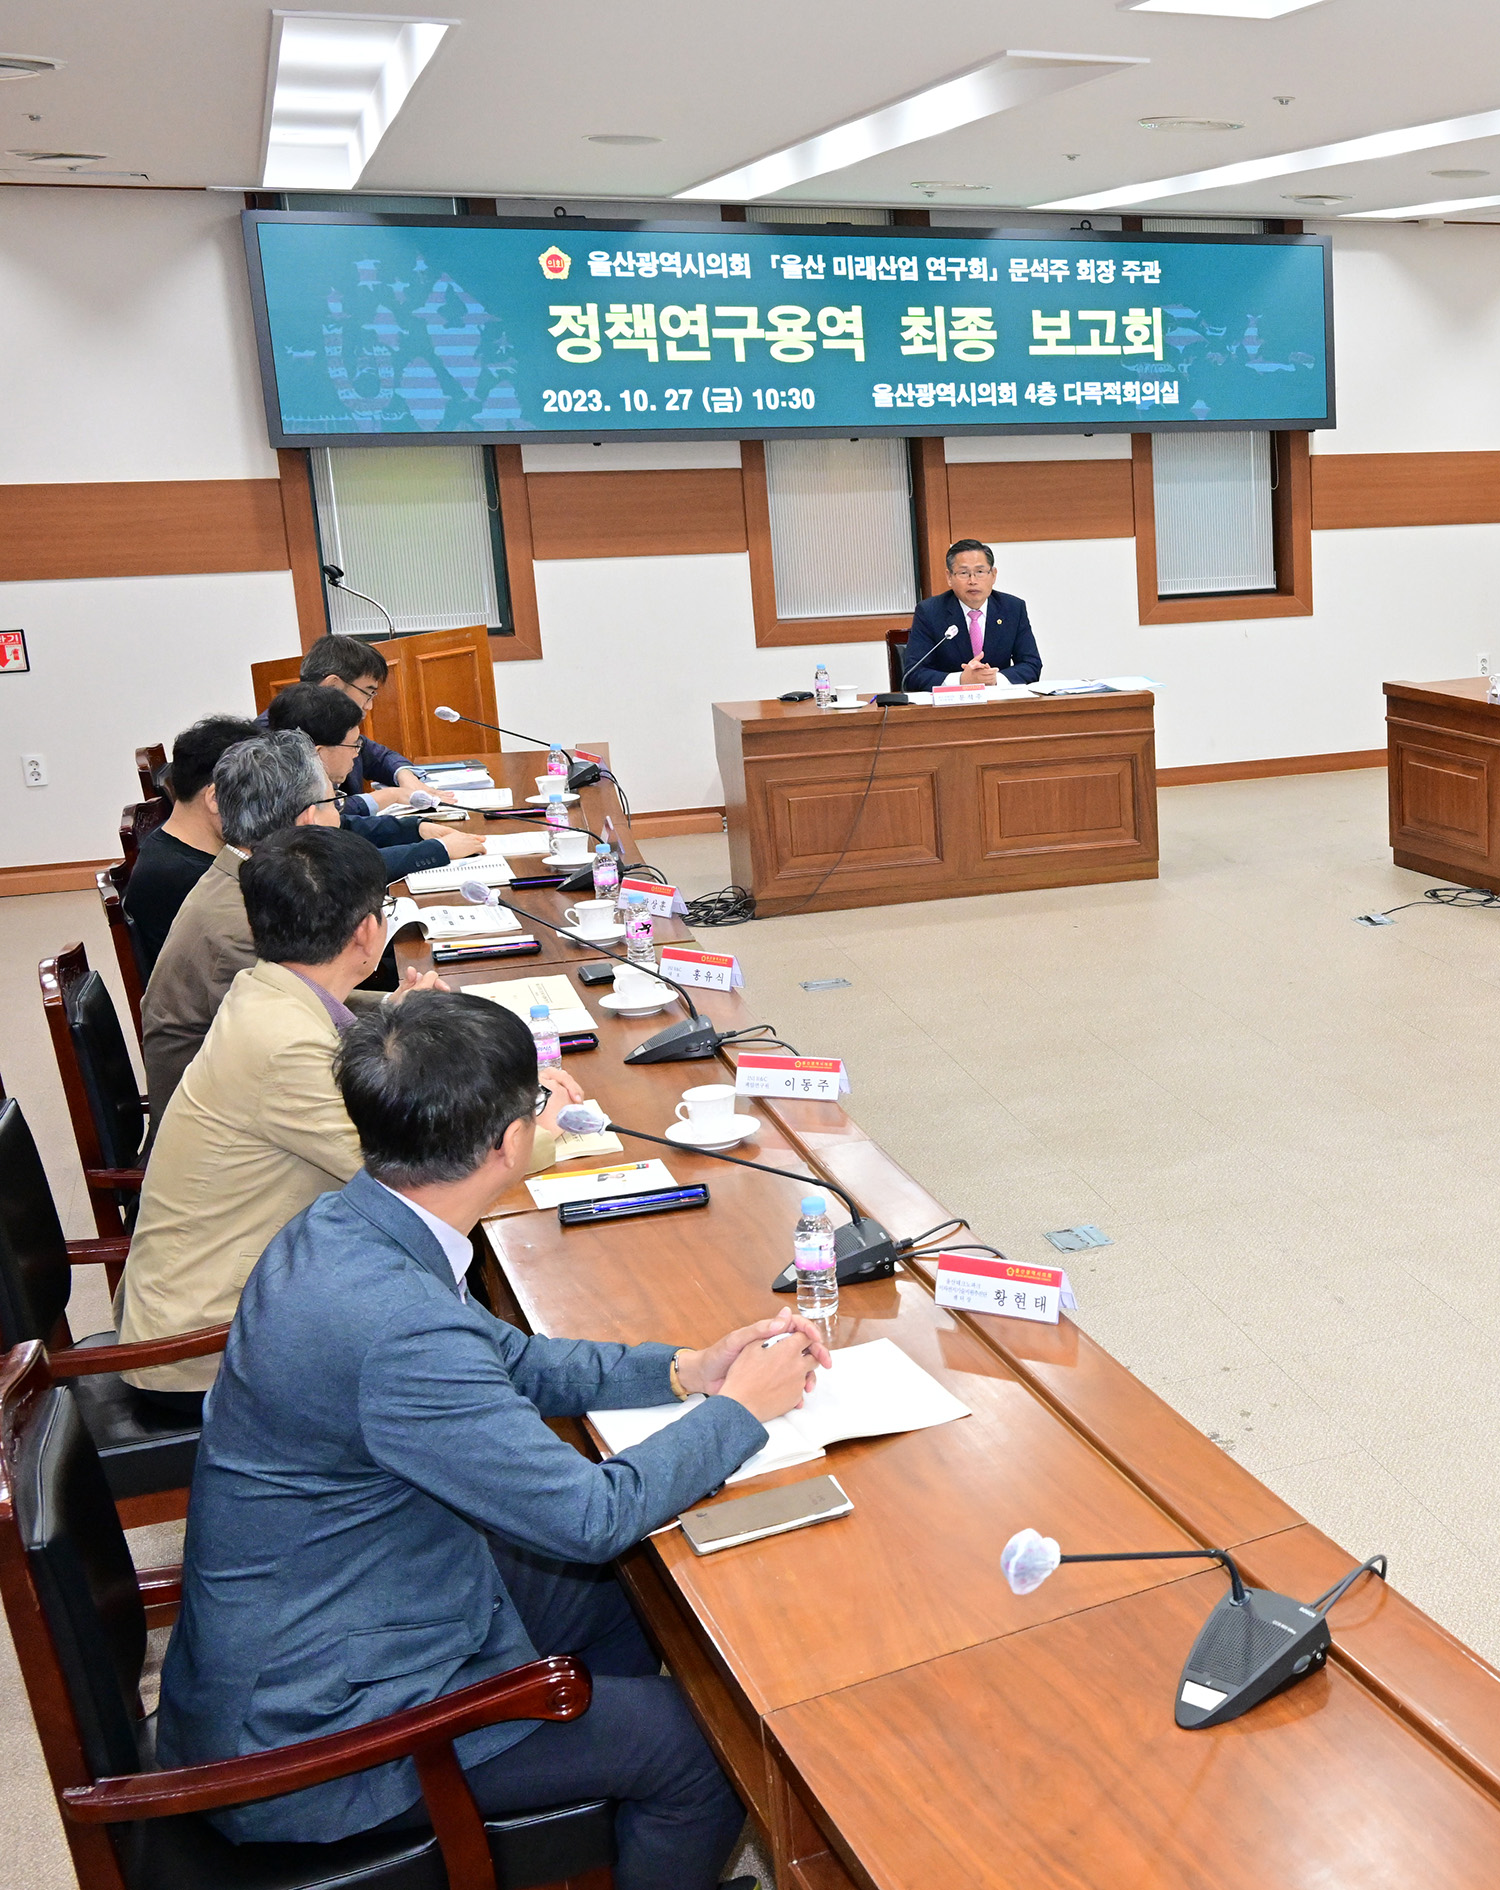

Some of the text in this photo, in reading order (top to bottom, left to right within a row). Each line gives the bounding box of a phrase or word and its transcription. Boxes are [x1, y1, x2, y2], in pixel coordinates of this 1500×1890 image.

[587, 250, 751, 279] 울산광역시의회
[833, 254, 919, 281] 미래산업
[1008, 258, 1070, 283] 문석주
[1076, 259, 1116, 284] 회장
[1121, 260, 1161, 284] 주관
[548, 302, 1164, 363] 정책연구용역 최종 보고회
[542, 386, 816, 413] 2023. 10. 27 (금) 10:30
[872, 380, 1179, 407] 울산광역시의회 4층 다목적회의실
[784, 1077, 830, 1092] 이동주
[993, 1288, 1047, 1314] 황현태
